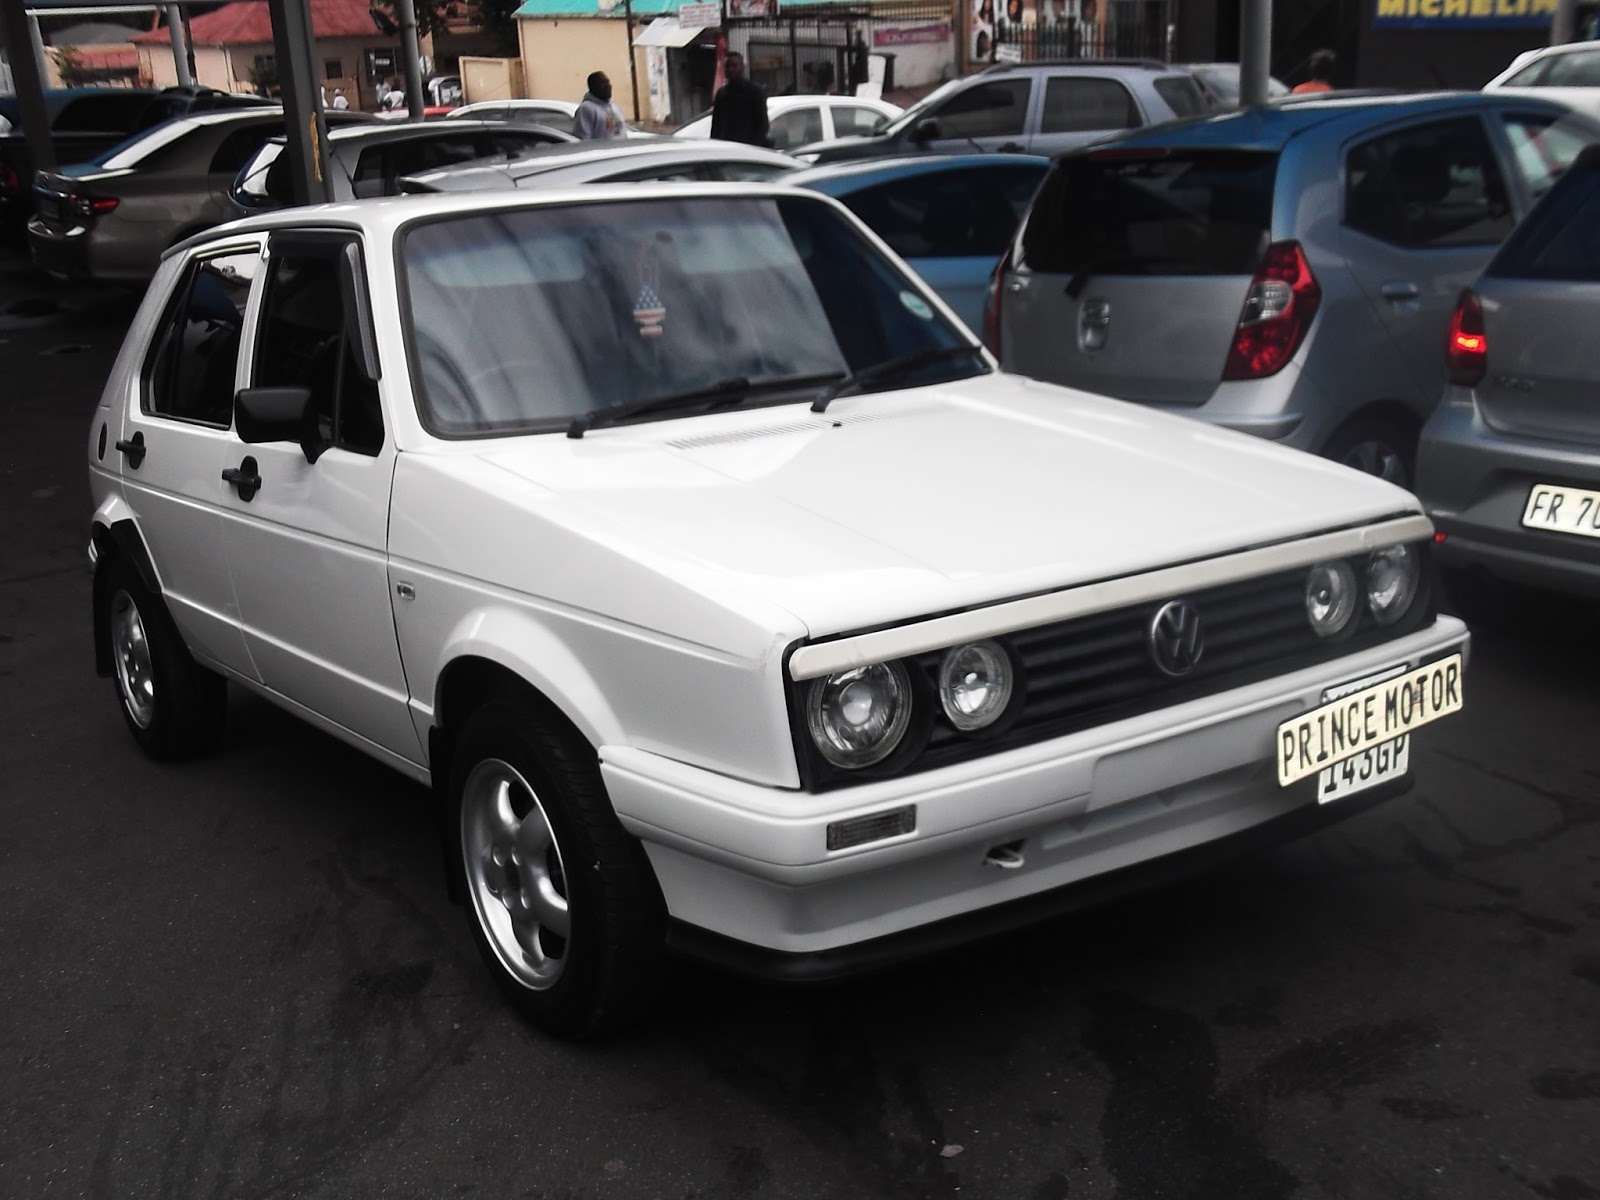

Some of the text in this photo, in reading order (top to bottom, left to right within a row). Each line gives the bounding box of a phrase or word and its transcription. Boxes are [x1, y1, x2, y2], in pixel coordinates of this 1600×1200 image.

[1376, 0, 1559, 18] MICHELIN
[1530, 491, 1565, 523] FR
[1282, 662, 1459, 777] PRINCE MOTOR
